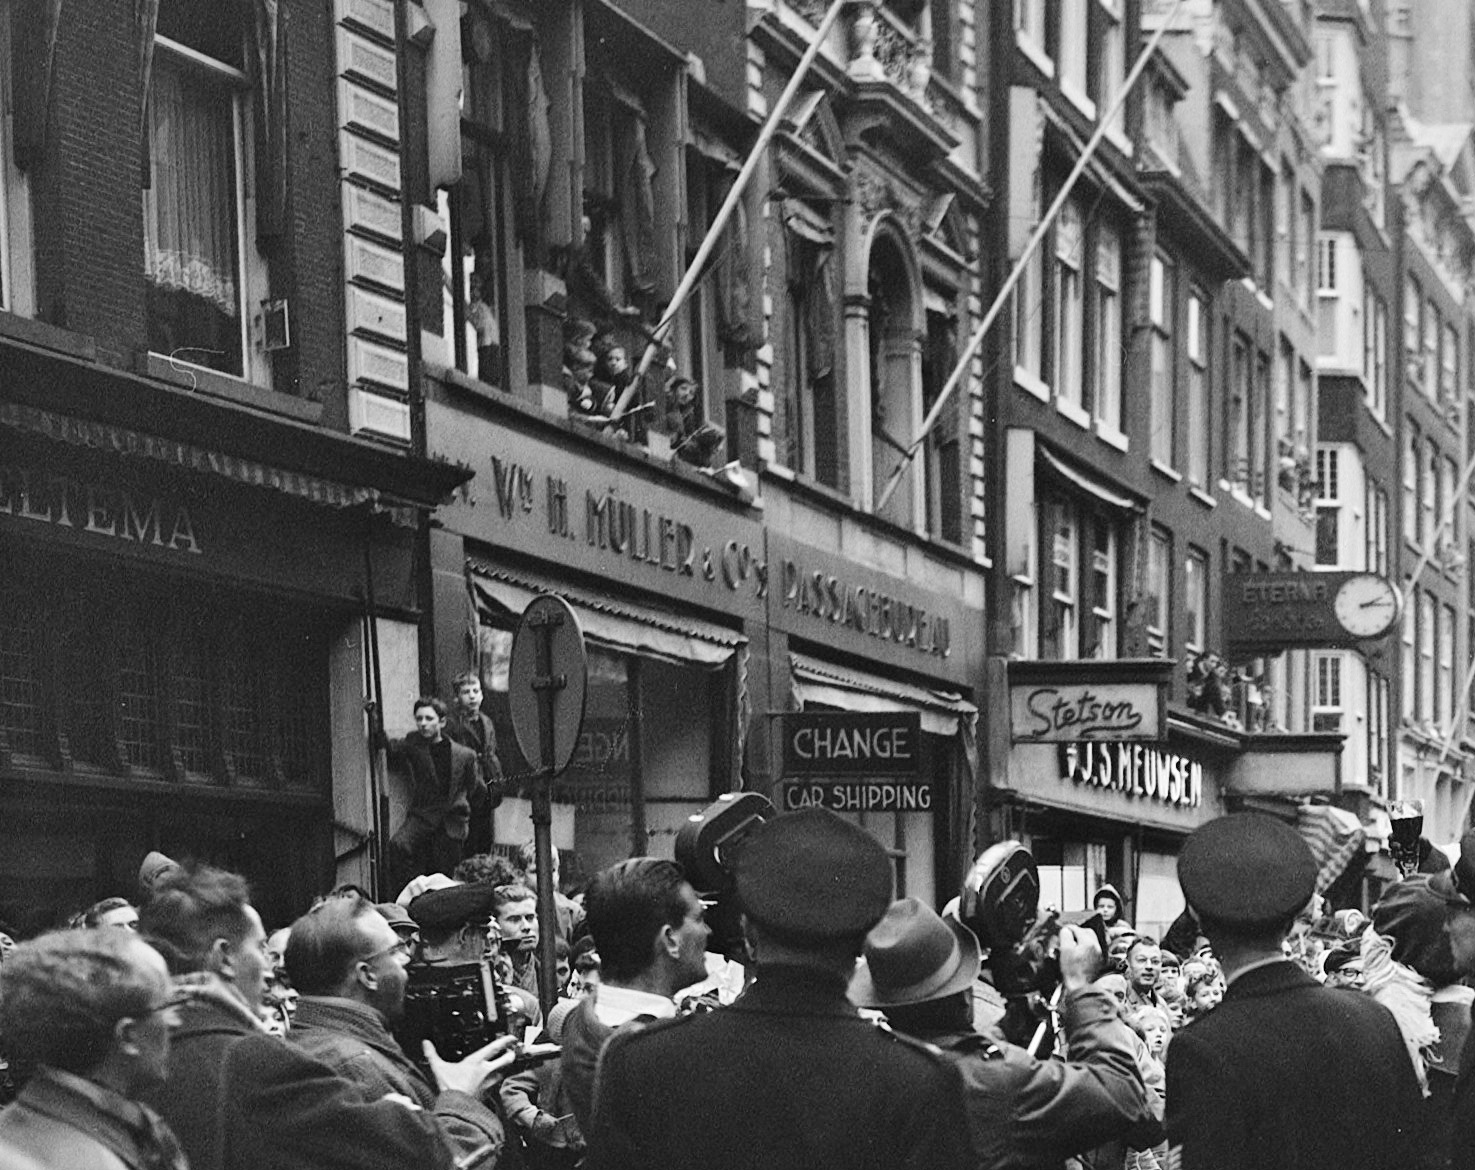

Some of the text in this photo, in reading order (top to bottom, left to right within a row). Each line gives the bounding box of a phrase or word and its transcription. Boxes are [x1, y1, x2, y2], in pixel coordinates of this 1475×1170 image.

[585, 486, 696, 578] MÜLLER
[1242, 579, 1328, 603] ETERNA
[1027, 688, 1143, 738] Stetson
[793, 727, 911, 759] CHANGE
[786, 784, 932, 810] CAR SHIPPING
